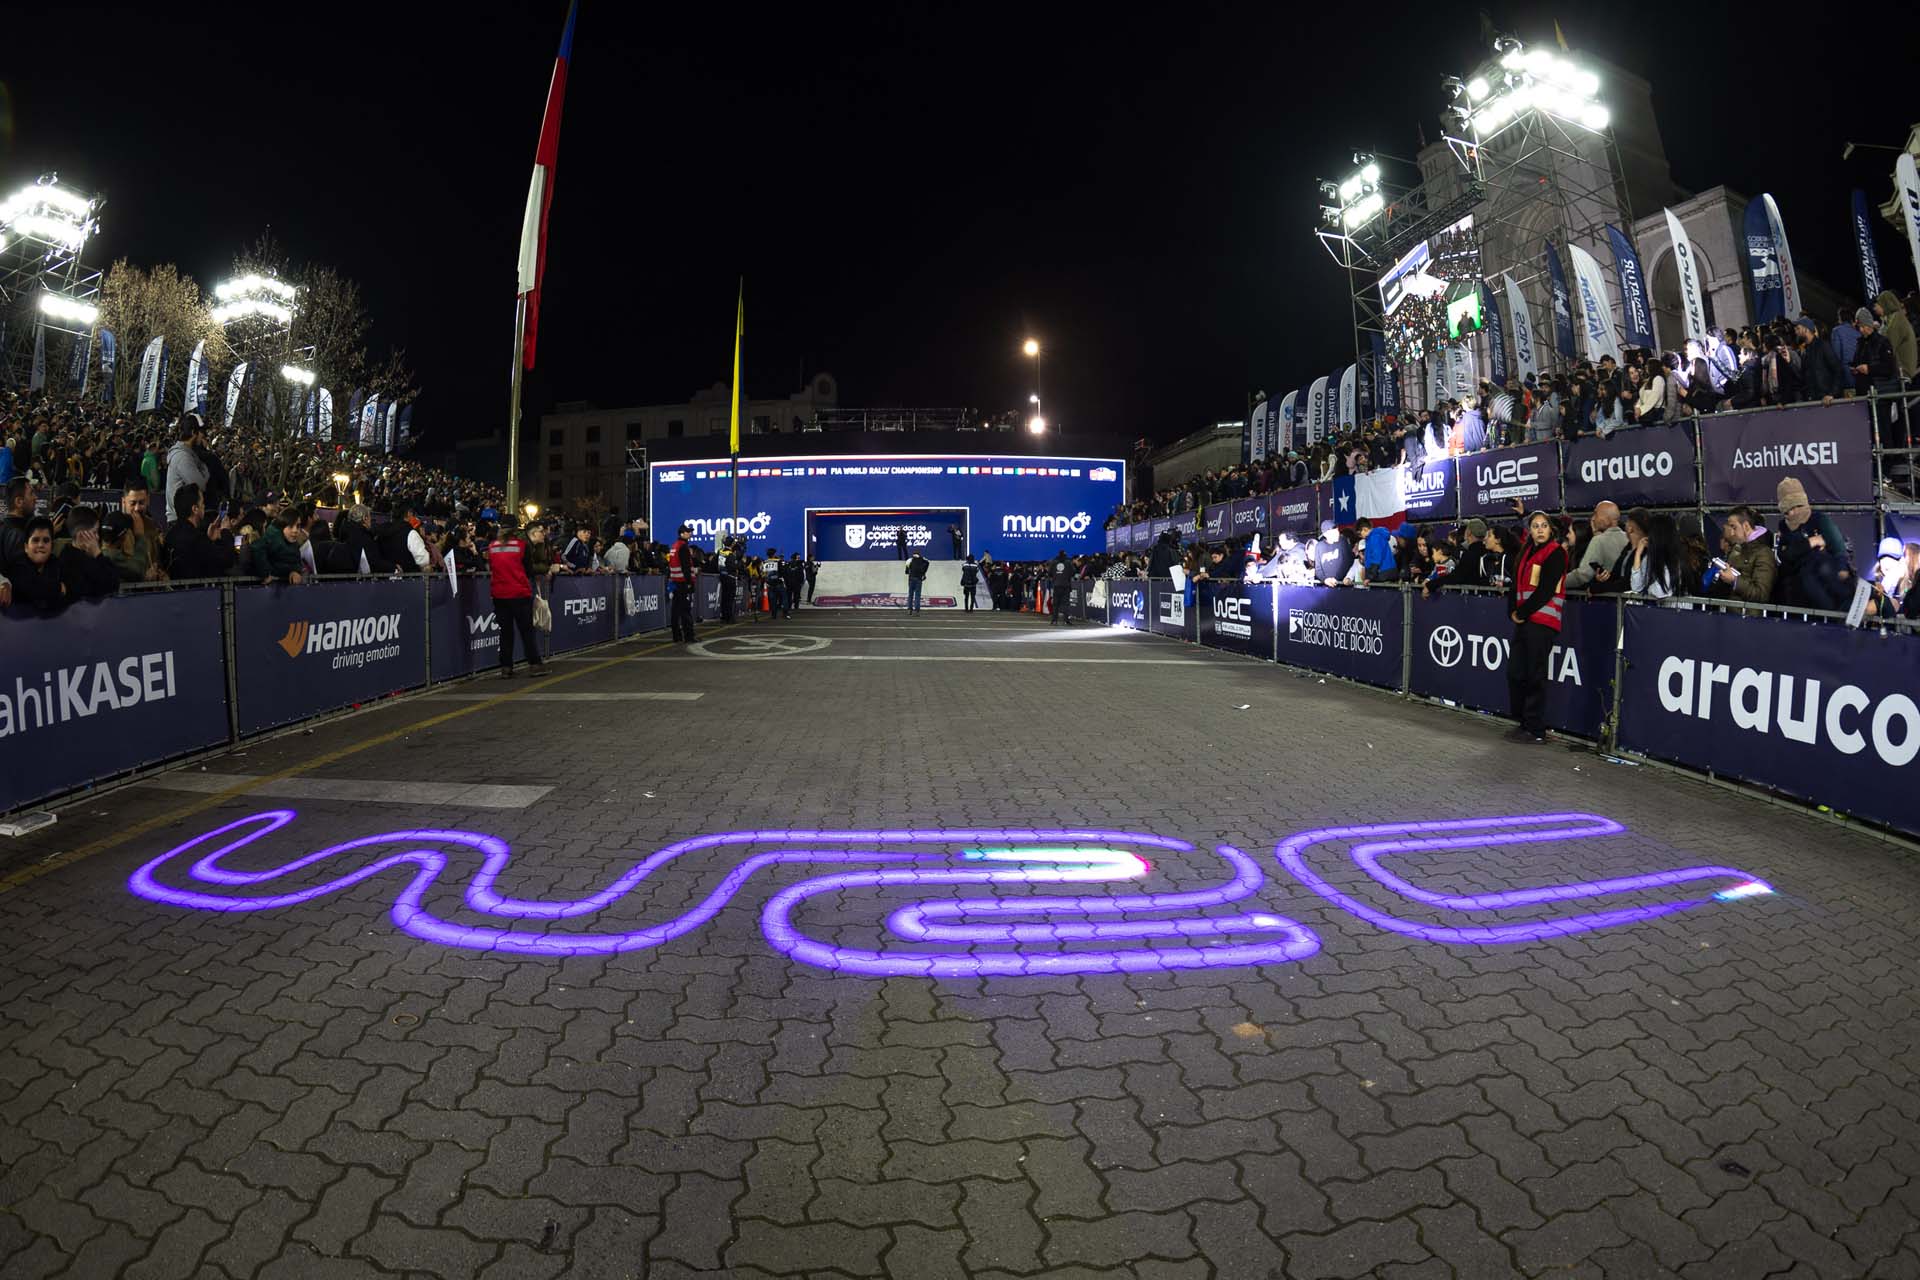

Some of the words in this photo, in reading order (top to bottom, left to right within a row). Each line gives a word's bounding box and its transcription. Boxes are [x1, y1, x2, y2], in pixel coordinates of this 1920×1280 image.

[1313, 392, 1324, 441] arauco
[1580, 451, 1673, 483] arauco
[1732, 442, 1839, 470] AsahiKASEI
[831, 467, 842, 475] FIA
[843, 467, 868, 475] WORLD
[869, 467, 891, 475] RALLY
[891, 466, 943, 475] CHAMPIONSHIP
[1476, 456, 1539, 487] WRC
[1234, 510, 1254, 524] COPEC
[1112, 592, 1132, 609] COPEC
[1213, 596, 1252, 622] WRC
[1303, 611, 1340, 631] GOBIERNO
[1341, 616, 1383, 637] REGIONAL
[1333, 631, 1348, 650] DEL
[1350, 635, 1383, 656] BIOBIO
[332, 650, 364, 671] driving
[365, 644, 400, 664] emotion
[1467, 634, 1582, 686] TOTA
[1658, 655, 1920, 767] arauco
